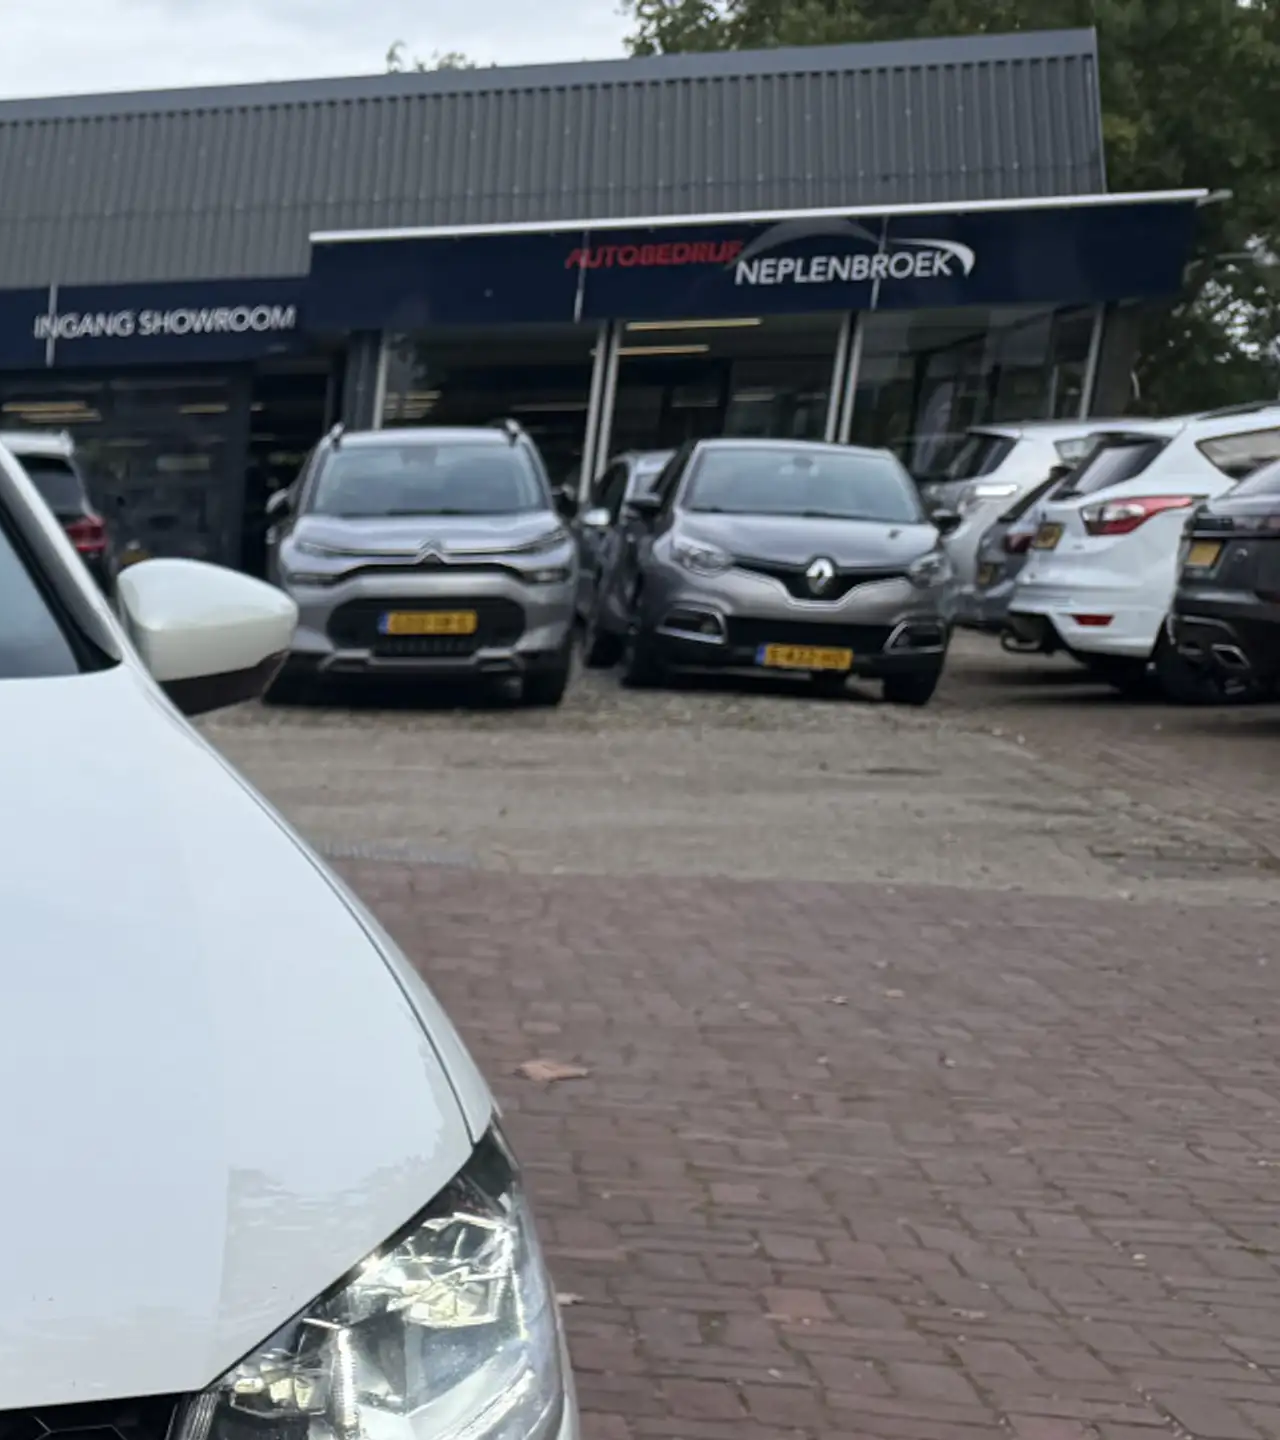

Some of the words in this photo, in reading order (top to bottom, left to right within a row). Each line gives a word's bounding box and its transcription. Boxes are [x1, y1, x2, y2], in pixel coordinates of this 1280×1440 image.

[734, 250, 953, 286] NEPLENBROEK
[34, 310, 134, 339] INGANG
[138, 304, 296, 335] SHOWROOM
